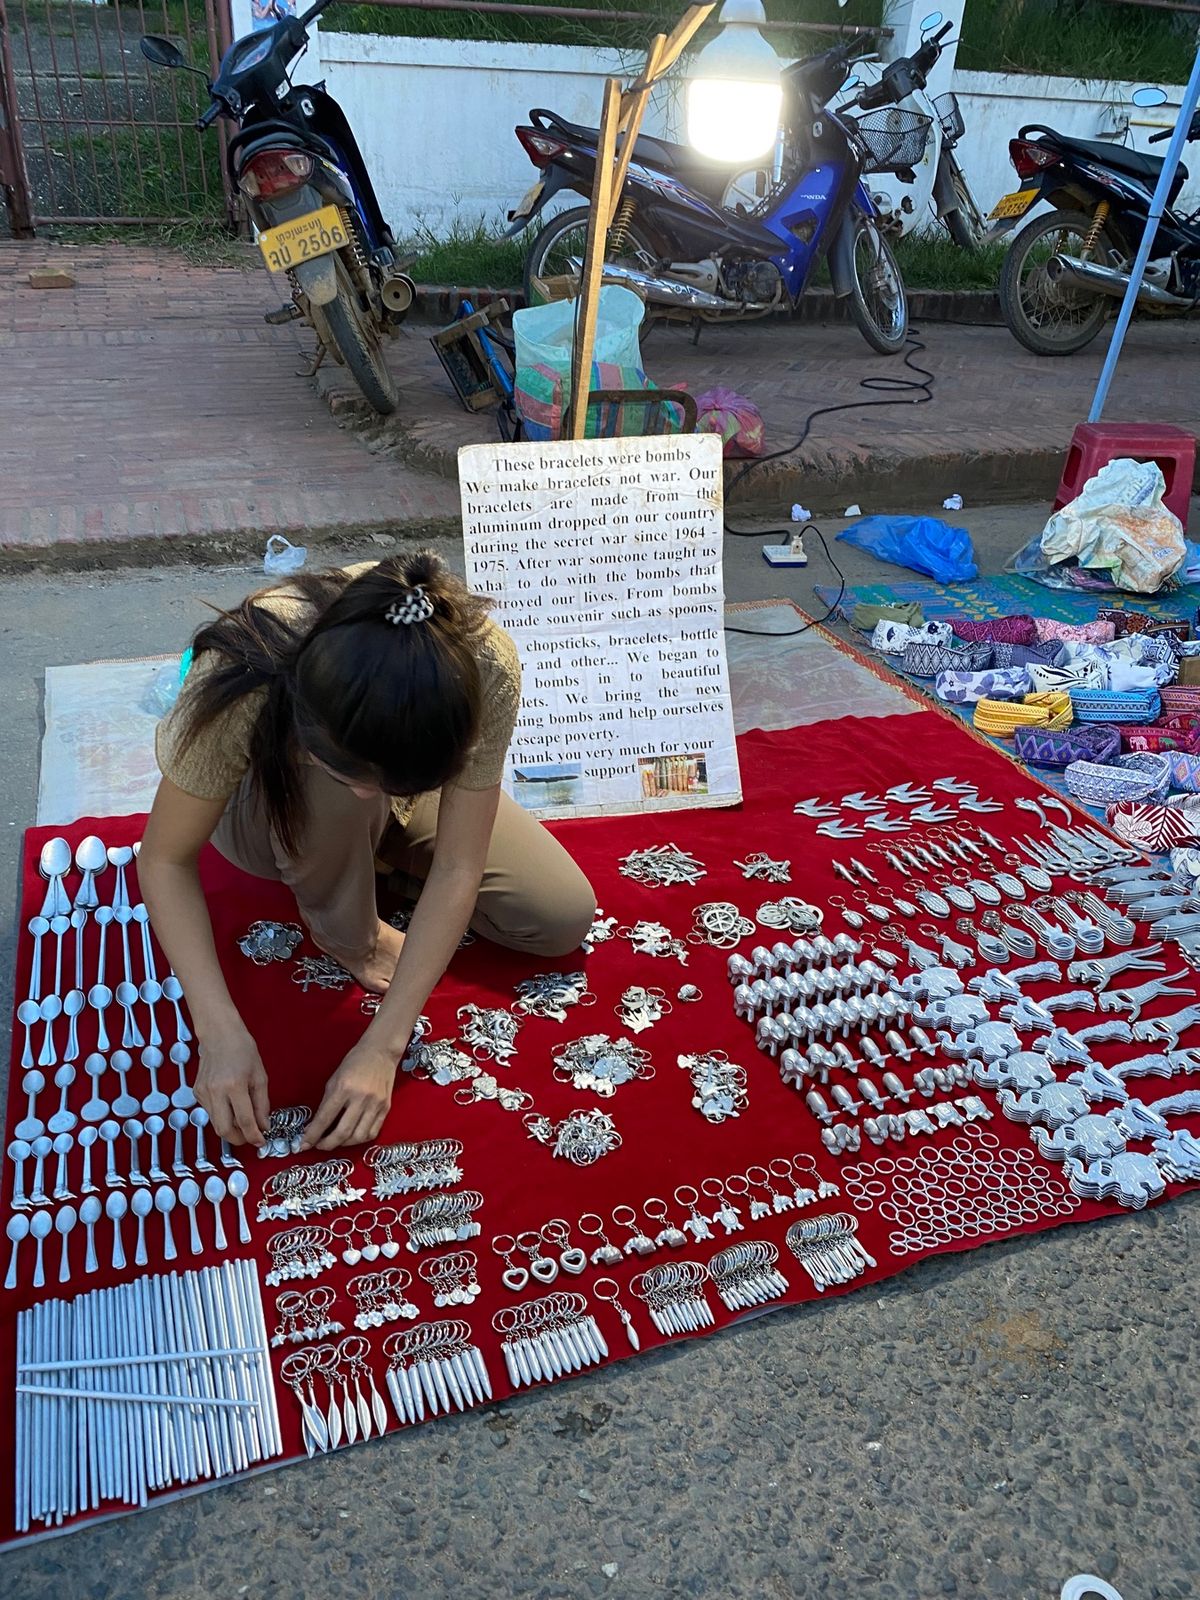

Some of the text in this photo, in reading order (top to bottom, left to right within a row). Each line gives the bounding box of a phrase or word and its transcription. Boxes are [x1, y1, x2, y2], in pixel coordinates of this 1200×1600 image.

[298, 225, 343, 257] 2506
[494, 449, 690, 471] These bracelets were bombs
[466, 468, 717, 493] We make bracelets not war. Our
[468, 488, 717, 514] bracelets are made from the
[470, 509, 716, 534] aluminum dropped on our country
[471, 541, 518, 554] during
[526, 538, 546, 550] the
[554, 536, 593, 548] secret
[602, 535, 627, 544] war
[635, 531, 667, 542] since
[677, 526, 705, 539] 1964
[474, 547, 716, 573] 1975. After war someone taught us
[475, 565, 715, 591] wha to do with the bombs that
[498, 583, 716, 611] troyed our lives. From bombs
[503, 615, 539, 627] made
[547, 610, 604, 624] souvenir
[612, 607, 640, 619] such
[648, 608, 661, 616] as
[527, 628, 717, 653] chopsticks, bracelets, bottle
[537, 657, 561, 670] and
[628, 652, 649, 662] We
[659, 650, 697, 663] began
[707, 648, 718, 657] to
[535, 664, 720, 688] bombs in to beautiful
[566, 694, 587, 704] We
[606, 690, 641, 703] bring
[659, 687, 678, 698] the
[696, 686, 722, 695] new
[549, 712, 593, 724] bombs
[599, 709, 622, 721] and
[630, 707, 656, 720] help
[663, 702, 723, 715] ourselves
[517, 735, 560, 746] escape
[565, 730, 619, 745] poverty.
[509, 740, 714, 764] Thank you very much for your
[585, 764, 635, 779] support
